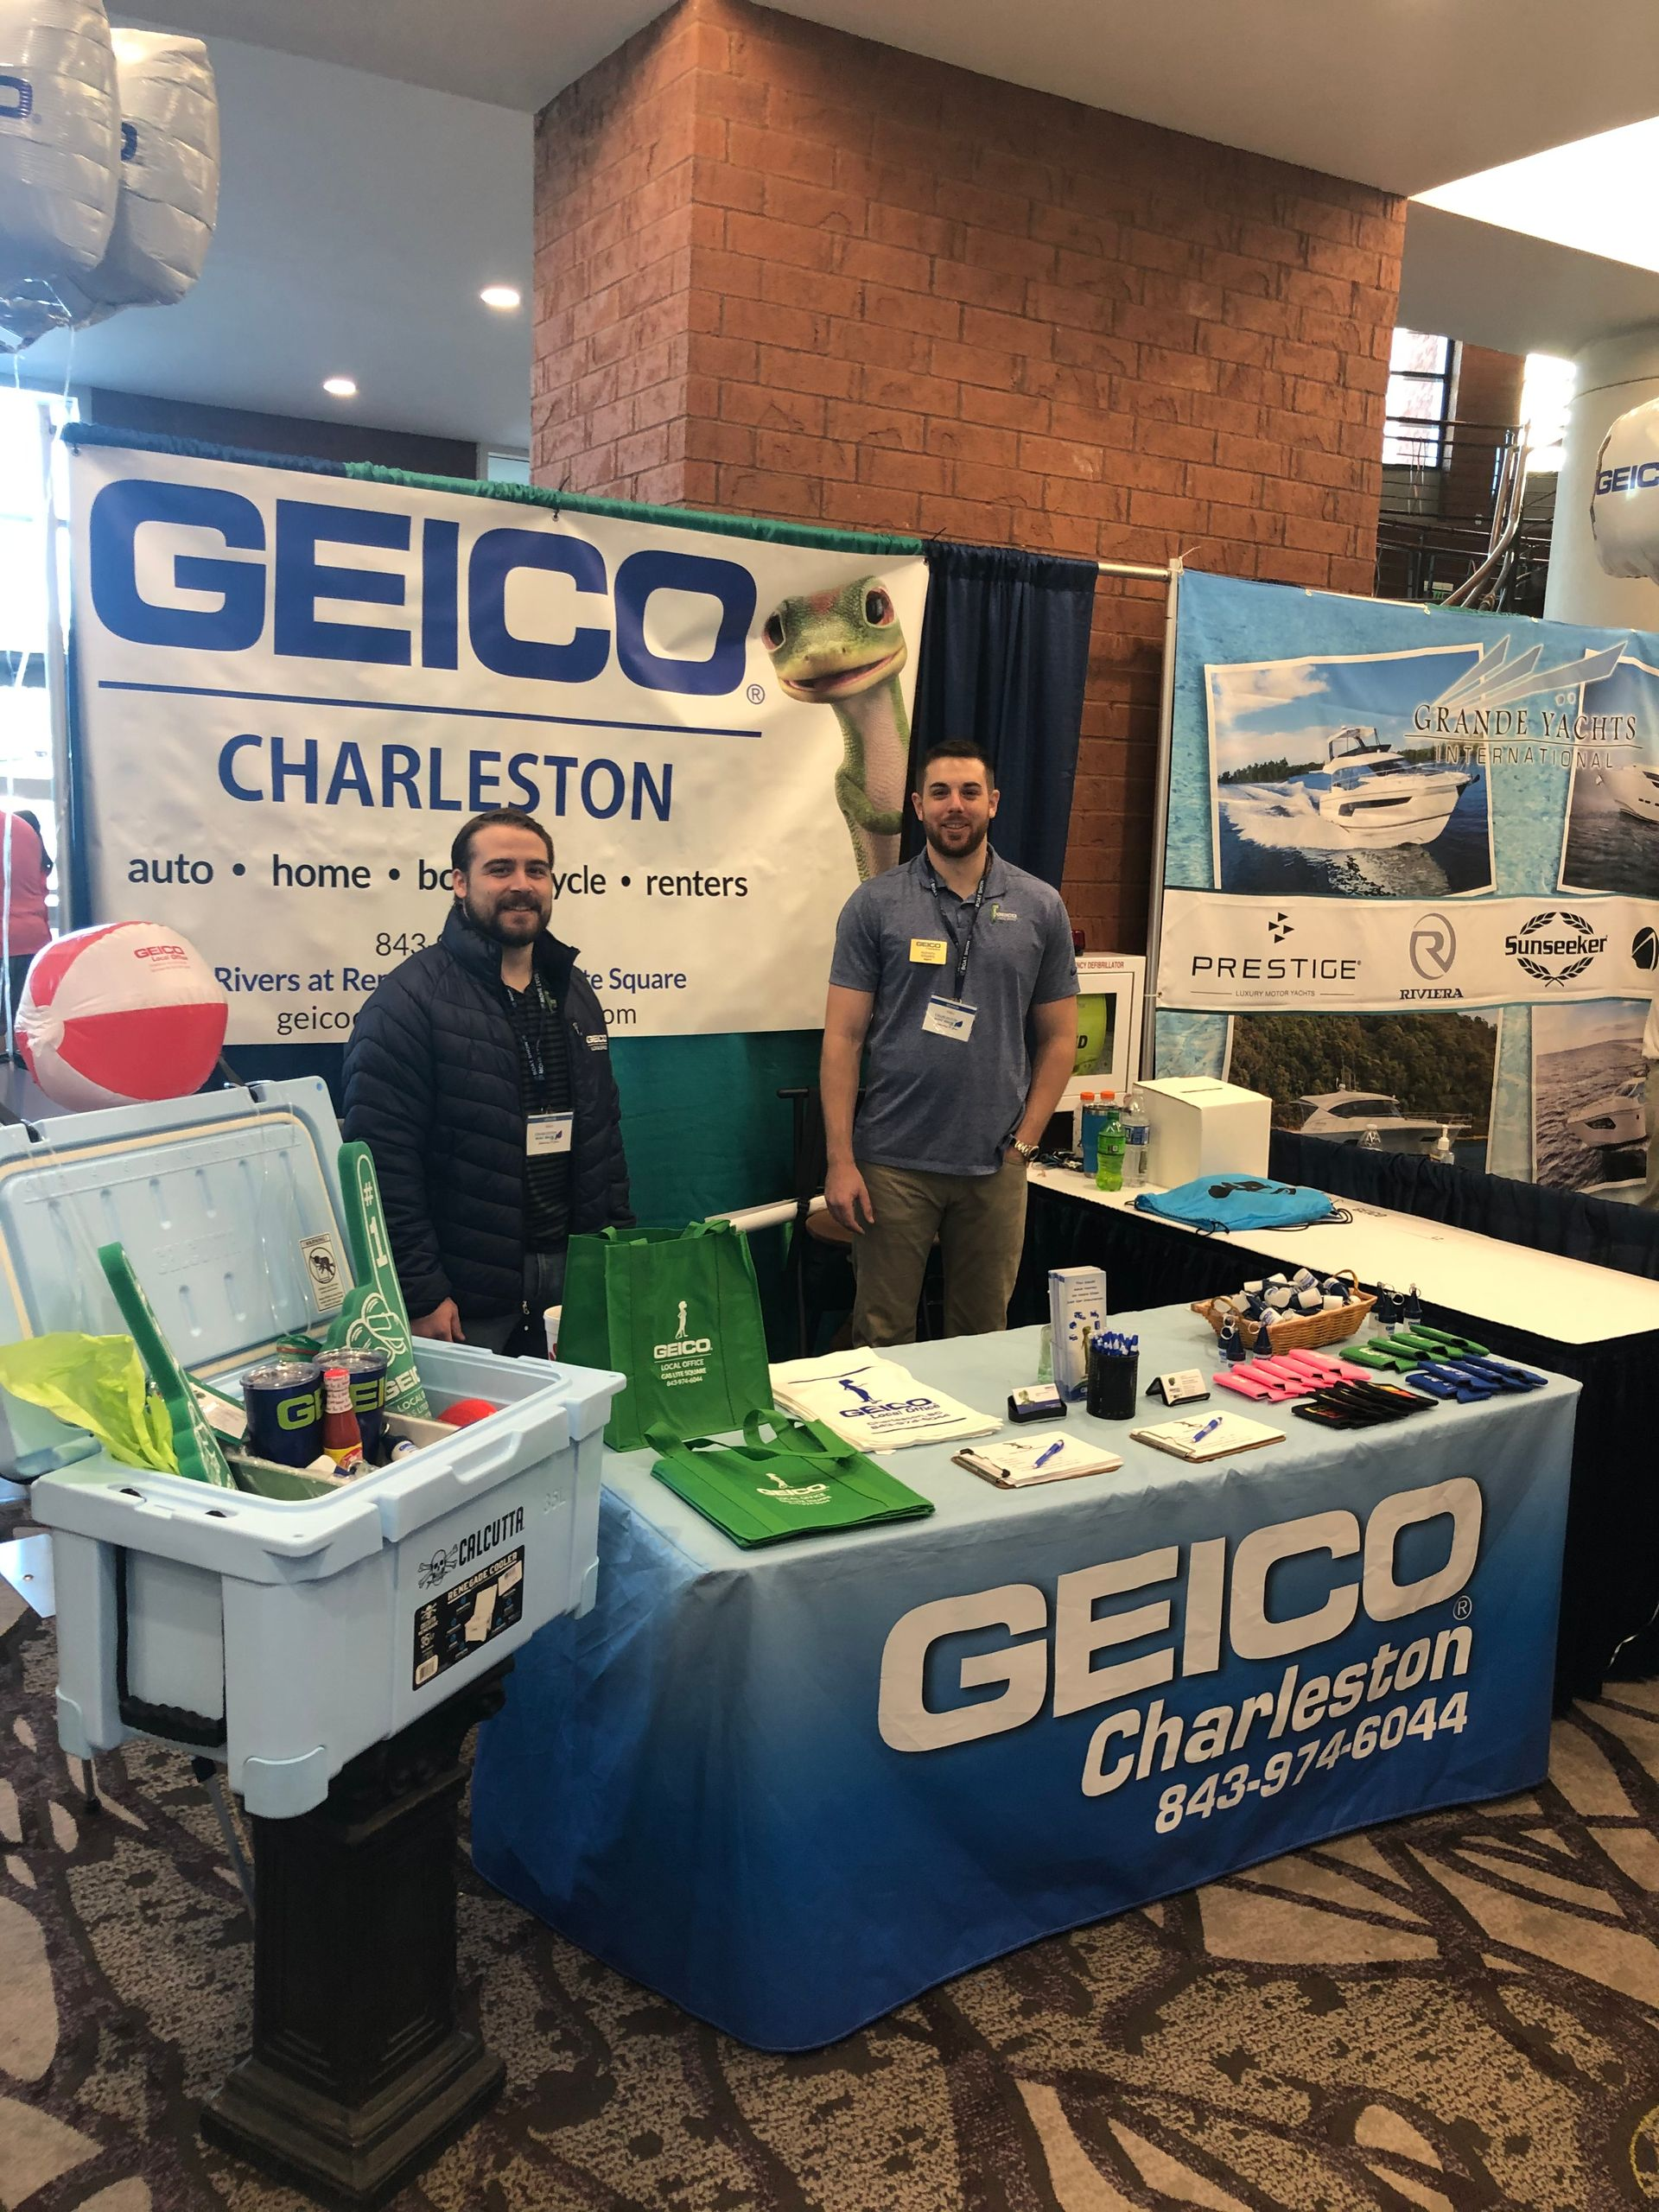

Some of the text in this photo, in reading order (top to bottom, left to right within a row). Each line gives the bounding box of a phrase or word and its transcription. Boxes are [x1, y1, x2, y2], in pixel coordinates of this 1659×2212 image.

[1596, 462, 1659, 495] GEIC
[90, 479, 757, 696] GEICO
[1414, 704, 1637, 741] GRANDE YACHTS
[1434, 746, 1613, 768] INTERNATIONAL
[219, 734, 673, 822] CHARLESTON
[128, 854, 748, 899] auto home bo ycle renters
[134, 945, 185, 959] GEICO
[1505, 934, 1606, 957] Sunseeker
[1087, 960, 1124, 969] DEFIBRILLATOR
[1192, 956, 1357, 980] PRESTIGE
[308, 969, 334, 991] at
[608, 968, 687, 994] Square
[1400, 988, 1464, 1001] RIVIERA
[276, 1005, 362, 1035] geico
[653, 1338, 711, 1359] GEICO
[660, 1358, 705, 1371] LOCAL OFFICE
[684, 1368, 707, 1376] SQUARE
[839, 1398, 933, 1418] GEICO
[869, 1404, 941, 1420] Local Office
[756, 1484, 827, 1497] GEICO
[459, 1505, 524, 1566] CALCUTTA
[447, 1552, 518, 1600] RENEGADE COOLER
[878, 1477, 1483, 1753] GEICO
[1081, 1624, 1472, 1797] Charleston
[1154, 1691, 1469, 1834] 843-974-6044
